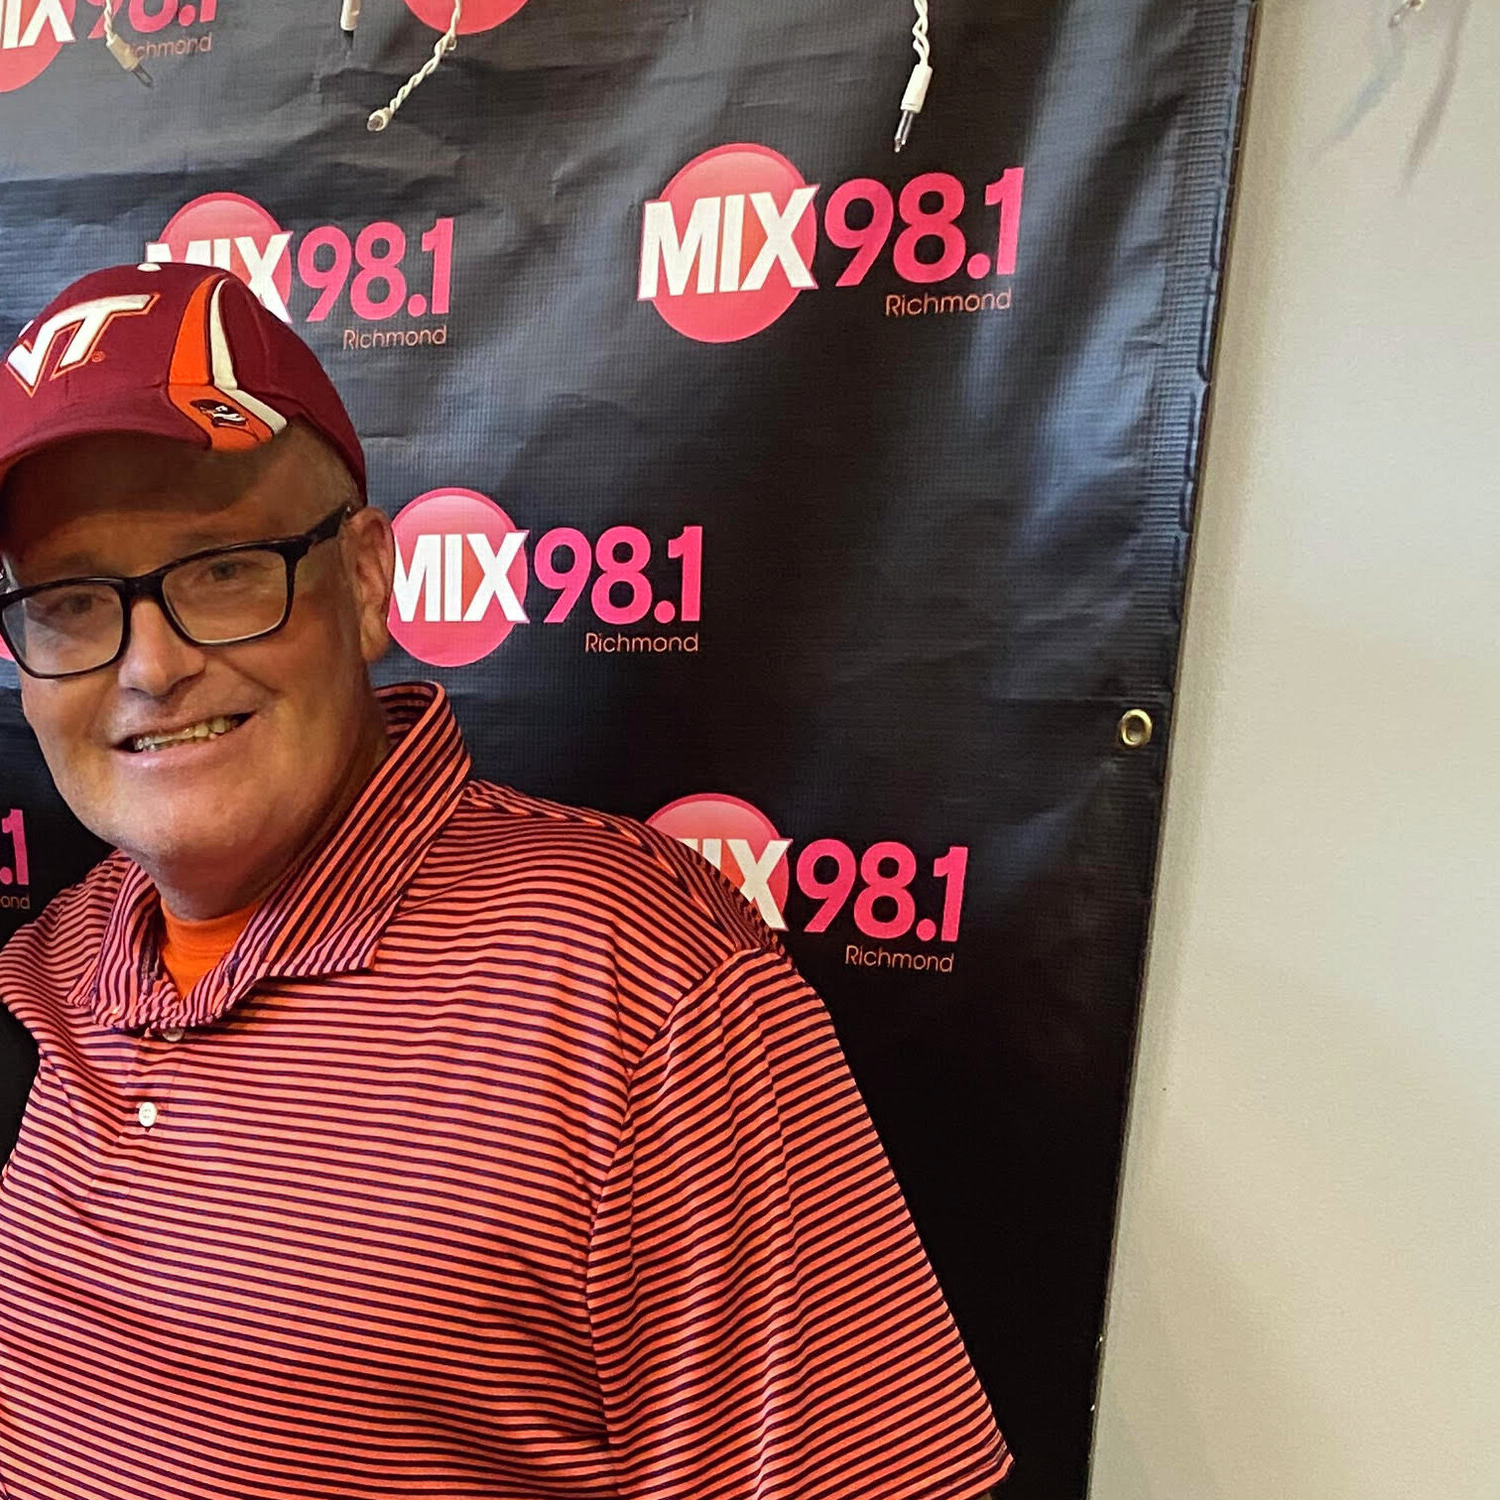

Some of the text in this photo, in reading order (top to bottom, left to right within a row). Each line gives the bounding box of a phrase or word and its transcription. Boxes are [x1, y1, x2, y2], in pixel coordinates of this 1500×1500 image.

[298, 217, 455, 323] 98.1
[637, 166, 1025, 302] MIX 98.1
[5, 292, 161, 398] VT
[343, 324, 448, 352] Richmond
[885, 287, 1012, 318] Richmond
[394, 525, 704, 626] MIX 98.1
[585, 631, 699, 654] Richmond
[797, 838, 969, 943] 98.1
[845, 944, 954, 974] Richmond
